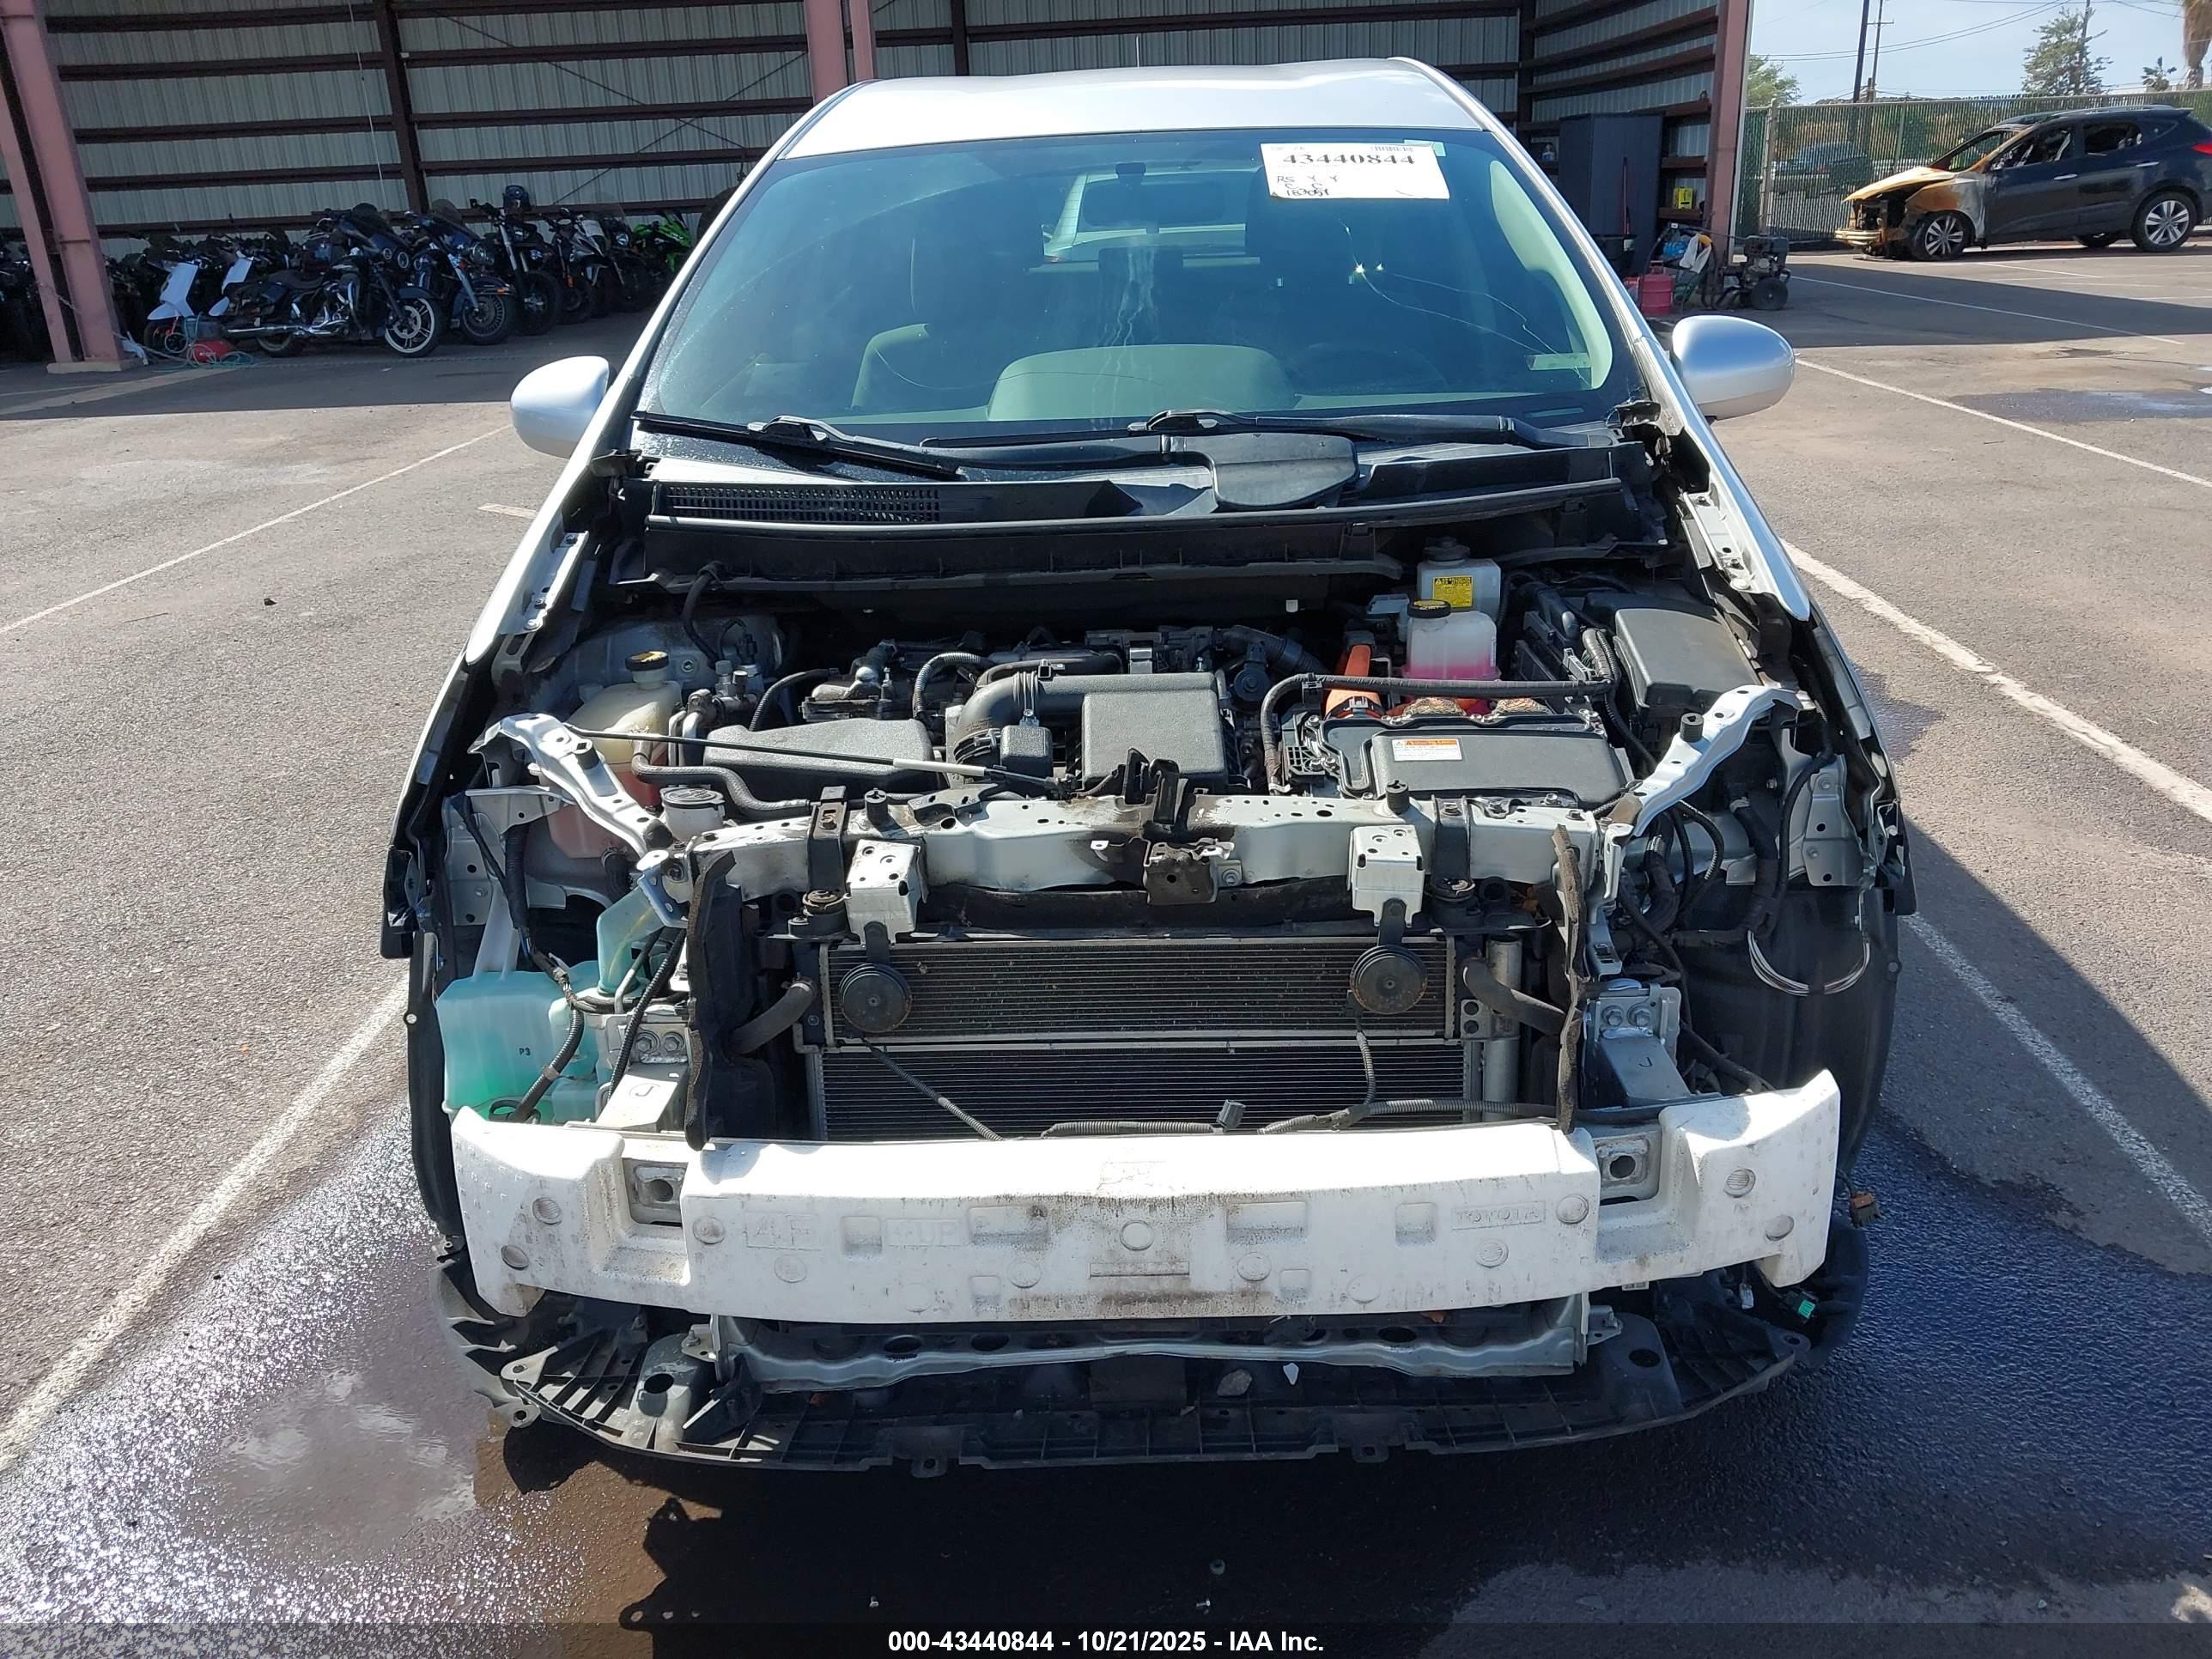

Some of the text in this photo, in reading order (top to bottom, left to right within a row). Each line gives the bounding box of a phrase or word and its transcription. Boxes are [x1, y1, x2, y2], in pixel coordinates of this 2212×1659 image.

[1283, 154, 1415, 165] 43440844
[519, 1048, 531, 1056] P3
[1458, 1207, 1539, 1224] TOYOTA
